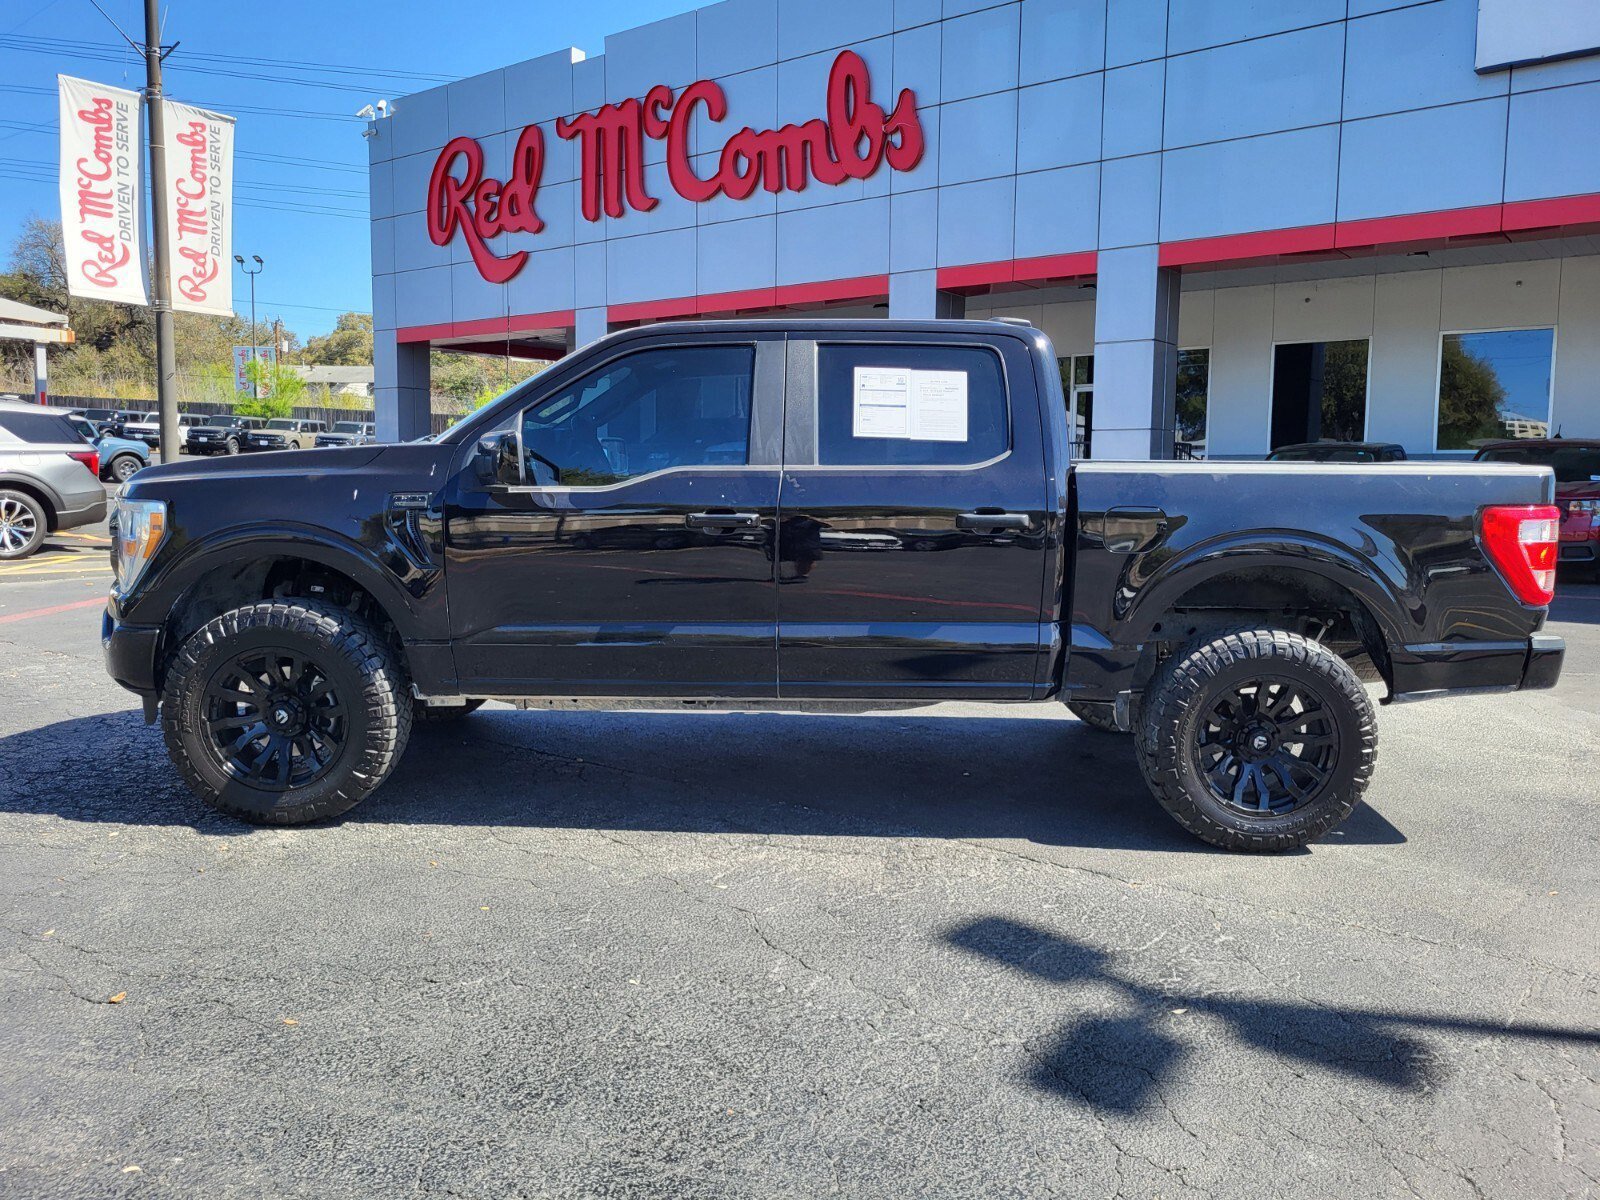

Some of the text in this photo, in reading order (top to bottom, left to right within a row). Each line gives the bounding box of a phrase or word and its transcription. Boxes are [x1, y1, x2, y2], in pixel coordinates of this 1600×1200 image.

[77, 98, 131, 288] Red McCombs
[116, 102, 132, 242] DRIVEN TO SERVE
[176, 121, 219, 303] Red McCombs
[210, 125, 222, 258] DRIVEN TO SERVE
[427, 49, 925, 284] Red McCombs
